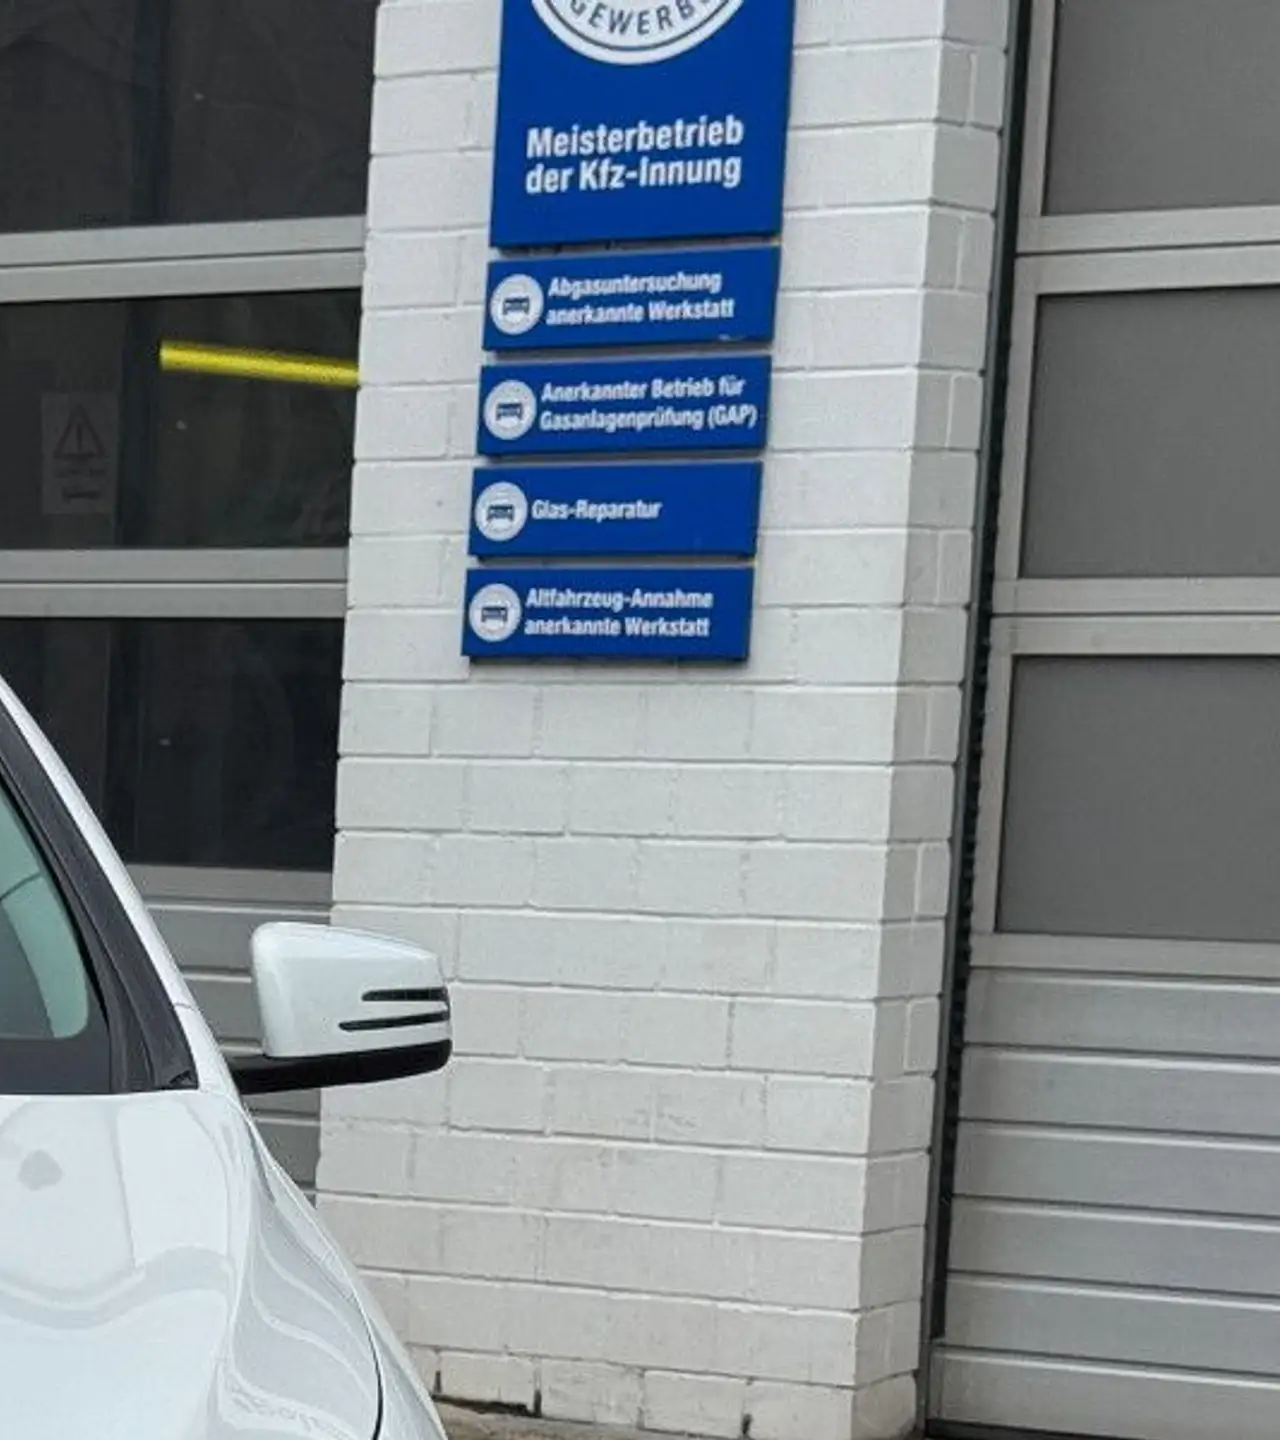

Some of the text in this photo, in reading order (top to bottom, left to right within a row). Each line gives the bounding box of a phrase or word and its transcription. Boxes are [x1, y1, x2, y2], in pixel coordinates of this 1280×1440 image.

[526, 114, 744, 159] Meisterbetrieb
[525, 155, 742, 194] der Kfz-Innung
[547, 271, 723, 300] Abgasuntersuchung
[546, 298, 735, 326] anerkannte Werkstatt
[541, 374, 746, 402] Anerkannter Betrieb für
[540, 403, 758, 433] Gasanlagenprüfung (GAP)
[531, 499, 664, 524] Glas-Reparatur
[525, 587, 714, 613] Altfahrzeug-Annahme
[523, 616, 711, 637] anerkannte Werkstatt
